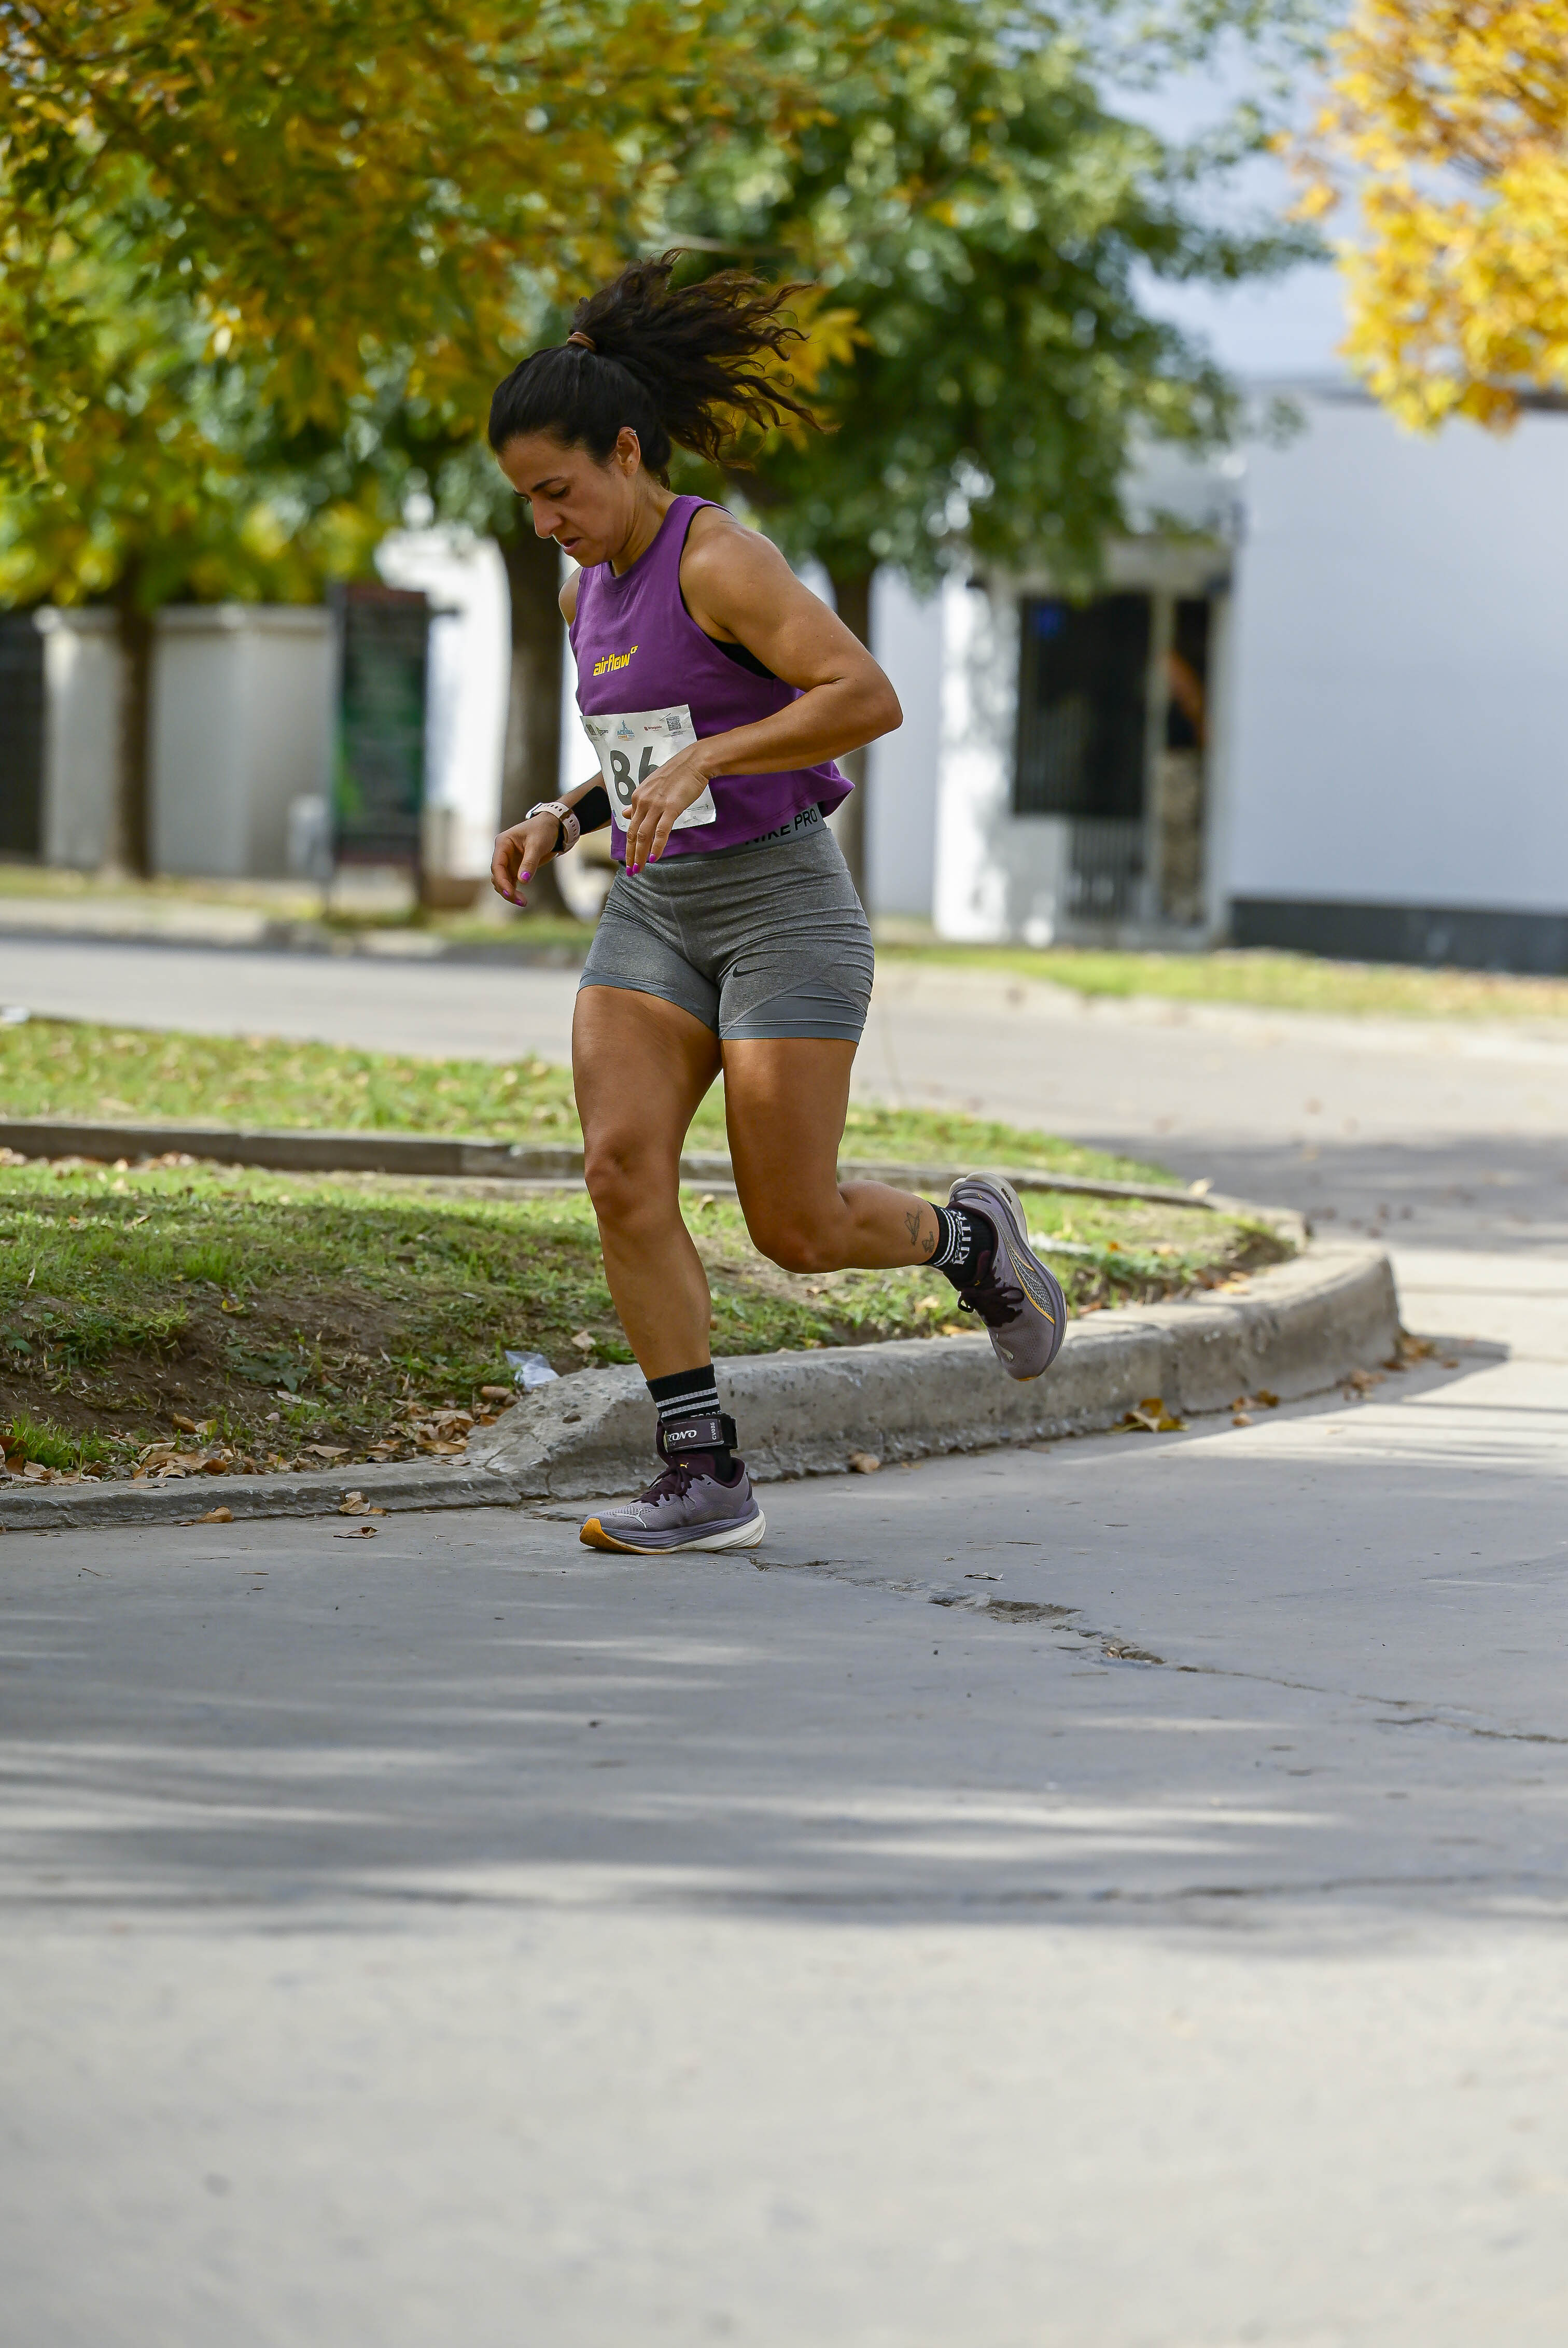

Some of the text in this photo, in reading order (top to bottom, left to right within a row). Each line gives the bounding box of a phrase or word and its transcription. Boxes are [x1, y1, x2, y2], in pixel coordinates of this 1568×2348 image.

[593, 653, 631, 676] airflow
[610, 746, 660, 805] 86
[794, 808, 818, 831] PRO
[667, 1430, 697, 1442] RONO
